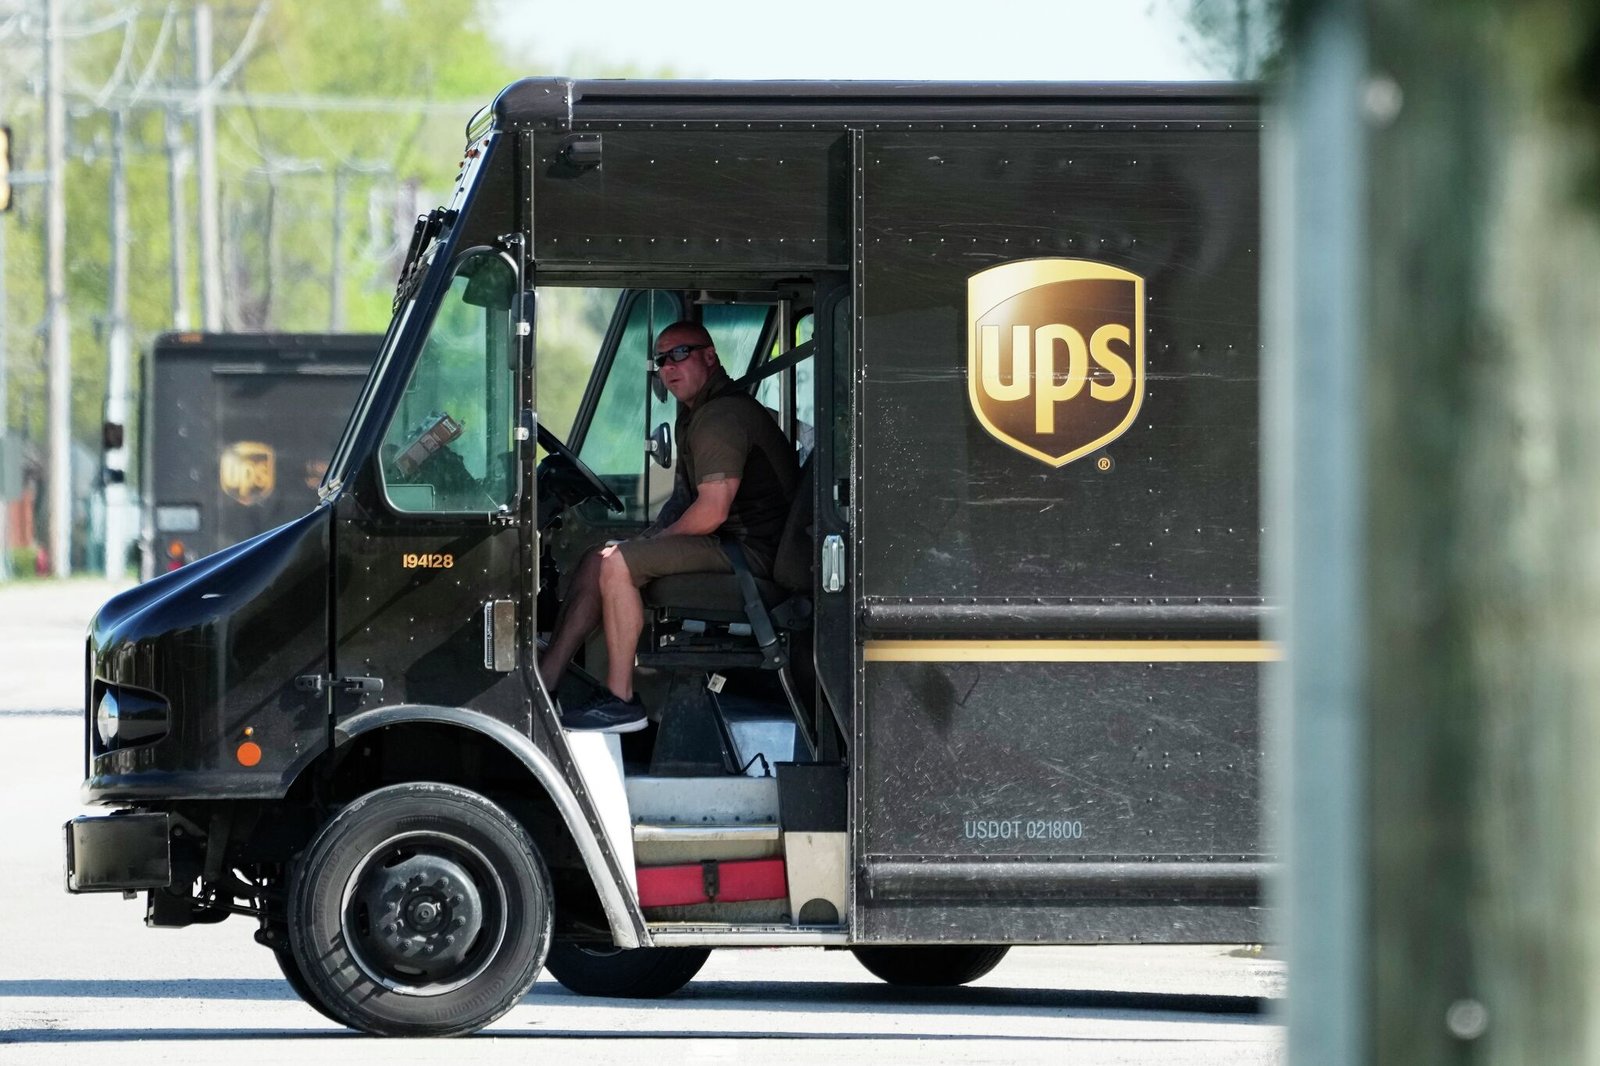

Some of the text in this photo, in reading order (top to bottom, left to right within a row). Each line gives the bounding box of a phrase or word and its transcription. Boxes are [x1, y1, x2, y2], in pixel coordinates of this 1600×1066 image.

[981, 323, 1133, 434] ups
[403, 554, 454, 569] 194128
[965, 821, 1082, 839] USDOT 021800
